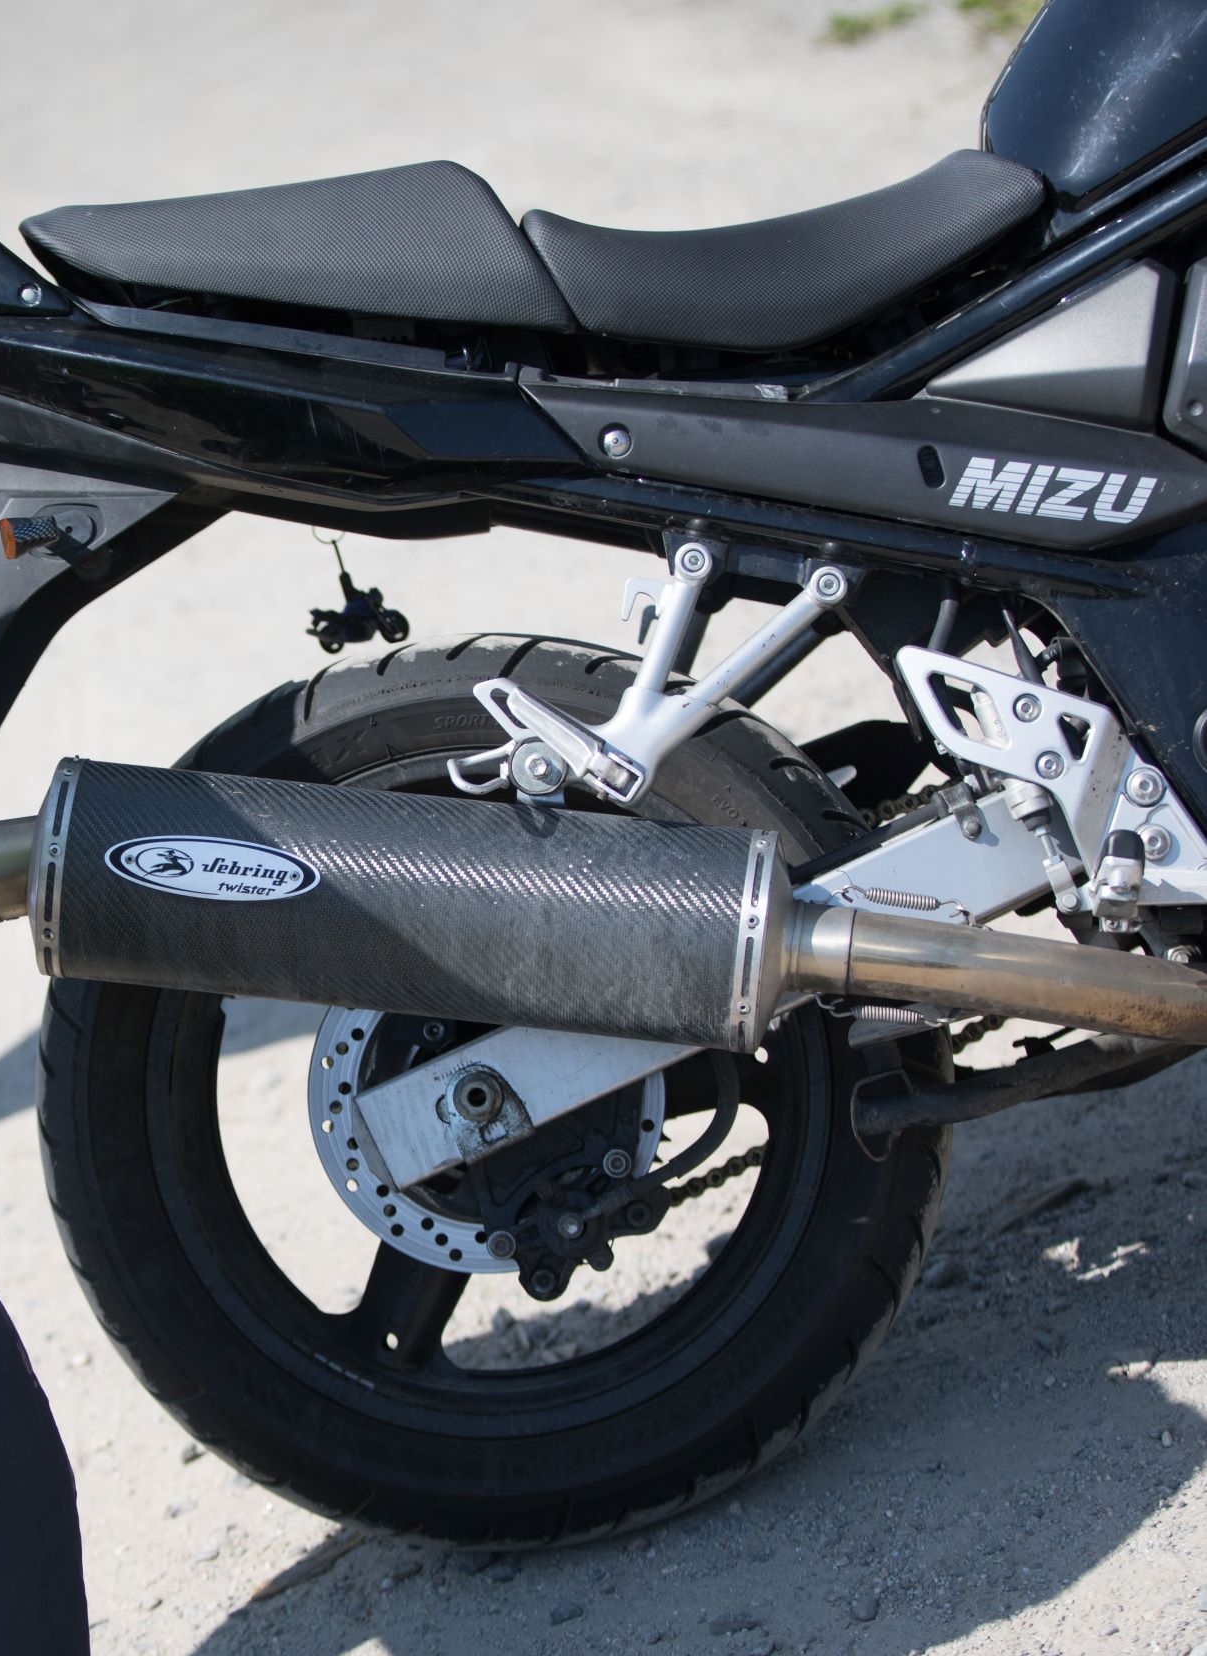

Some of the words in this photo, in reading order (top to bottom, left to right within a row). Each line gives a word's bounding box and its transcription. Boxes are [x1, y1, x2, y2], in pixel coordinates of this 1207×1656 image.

[948, 456, 1159, 525] MIZU
[201, 857, 290, 886] Sebring
[217, 881, 277, 897] twister
